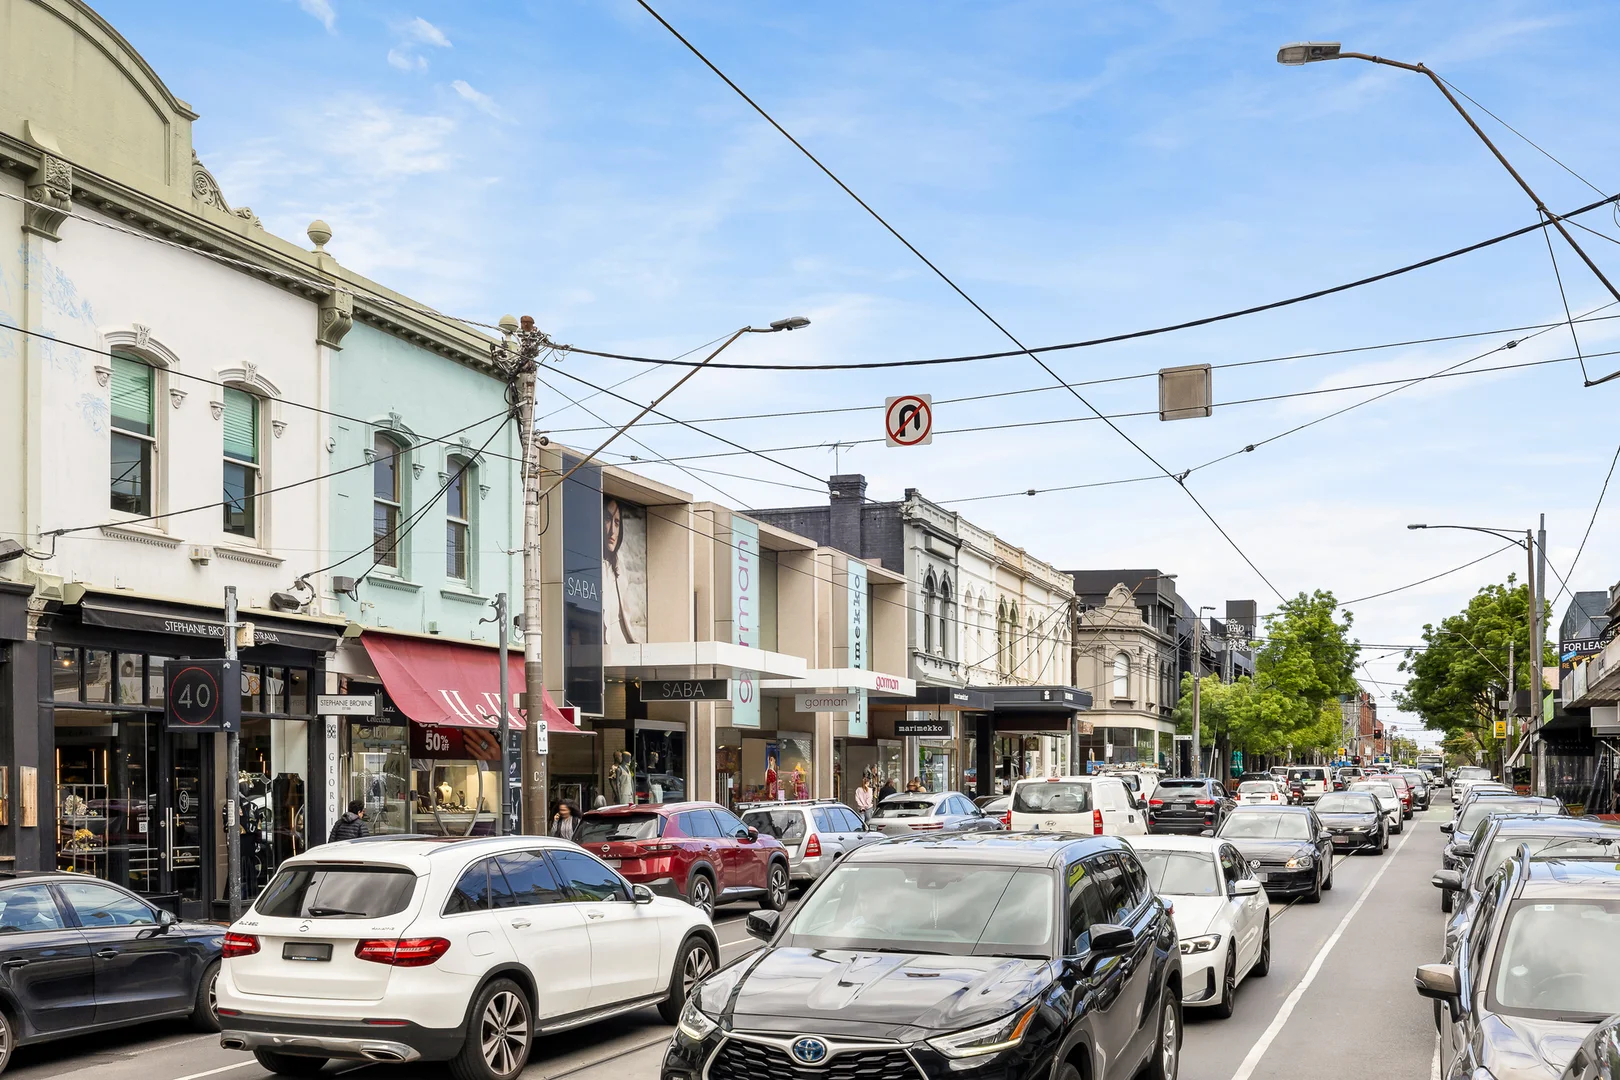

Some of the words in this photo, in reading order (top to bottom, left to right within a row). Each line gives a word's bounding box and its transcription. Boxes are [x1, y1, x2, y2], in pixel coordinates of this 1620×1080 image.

[567, 576, 598, 601] SABA
[165, 620, 208, 635] STEPHANIE
[208, 626, 226, 637] BRO
[738, 539, 753, 704] grman
[1563, 642, 1582, 652] FOR
[662, 682, 706, 698] SABA
[876, 676, 900, 691] gorman
[178, 683, 211, 709] 40
[320, 699, 349, 707] STEPHANIE
[349, 699, 373, 707] BROWNE
[804, 697, 848, 709] gorman
[898, 723, 944, 733] marimekko
[328, 752, 336, 832] GEORGI
